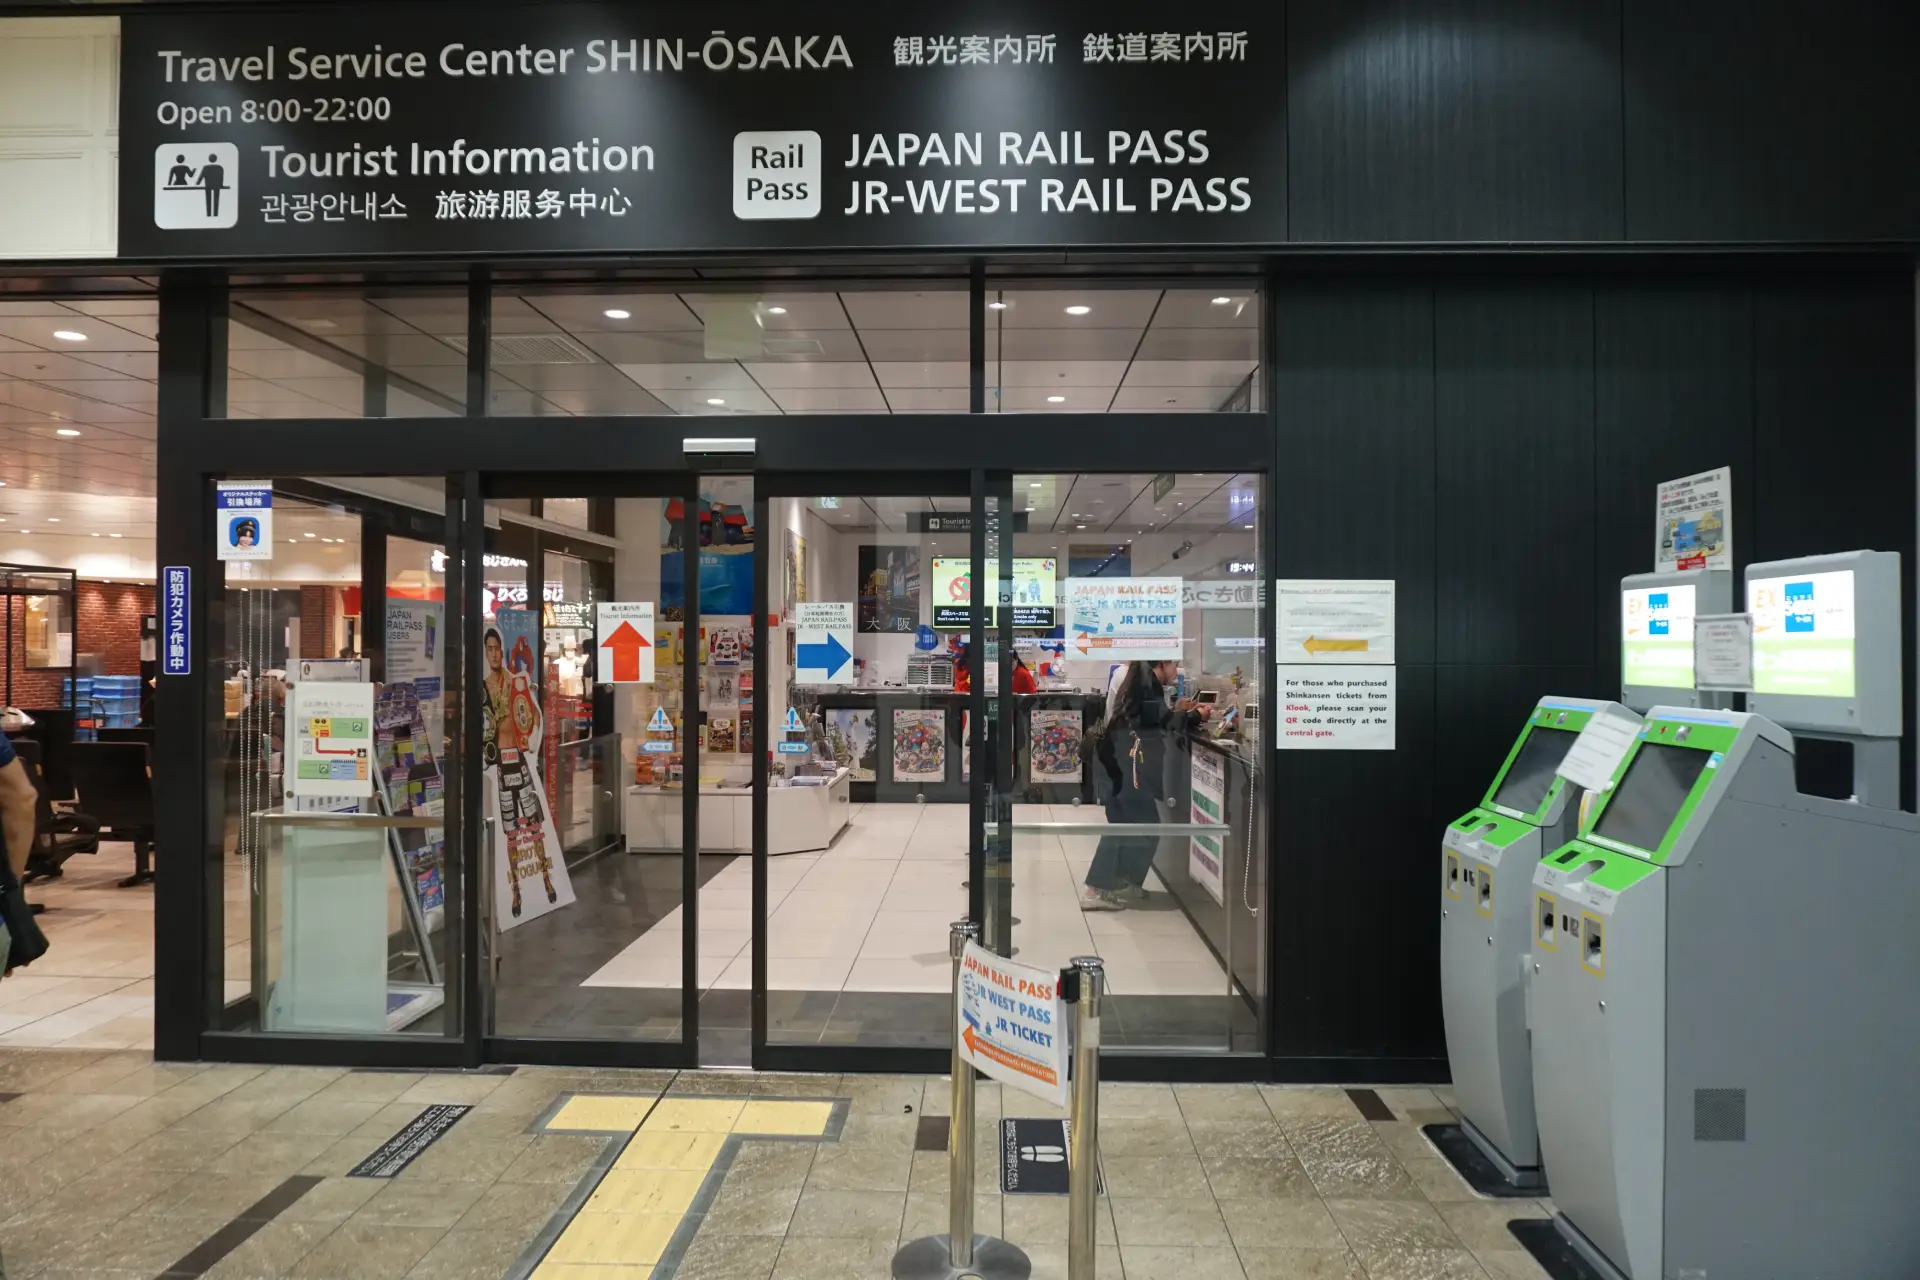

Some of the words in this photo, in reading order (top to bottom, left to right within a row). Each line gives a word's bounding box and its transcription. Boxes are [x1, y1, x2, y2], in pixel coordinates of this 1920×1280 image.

[158, 47, 275, 83] Travel
[288, 44, 426, 79] Service
[438, 43, 574, 77] Center
[586, 31, 854, 73] SHIN-ŌSAKA
[893, 34, 1057, 66] 観光案内所
[1082, 31, 1249, 64] 鉄道案内所
[157, 101, 232, 130] Open
[241, 97, 391, 124] 8:00-22:00
[261, 142, 398, 179] Tourist
[410, 138, 655, 175] Information
[750, 144, 804, 170] Rail
[845, 132, 983, 169] JAPAN
[1000, 131, 1095, 166] RAIL
[1108, 129, 1210, 165] PASS
[435, 188, 632, 221] 旅游服务中心
[746, 176, 809, 203] Pass
[845, 179, 1026, 216] JR-WEST
[1041, 177, 1136, 213] RAIL
[1150, 176, 1252, 212] PASS
[260, 192, 408, 224] 관광안내소
[1075, 585, 1115, 595] JAPAN
[1117, 585, 1144, 595] RAIL
[1148, 585, 1177, 595] PASS
[1113, 600, 1144, 609] WEST
[1148, 600, 1177, 609] PASS
[170, 570, 185, 670] 防犯カメラ作動中
[1119, 615, 1133, 624] JR
[1135, 615, 1177, 624] TICKET
[1347, 680, 1388, 688] purchased
[1316, 705, 1342, 713] please
[1326, 717, 1357, 725] directly
[1315, 730, 1335, 738] gate.
[964, 954, 989, 979] JAPAN
[991, 969, 1015, 991] RAIL
[1018, 978, 1052, 1001] PASS
[976, 983, 987, 999] JR
[988, 991, 1015, 1013] WEST
[1019, 1003, 1051, 1025] PASS
[995, 1016, 1008, 1033] JR
[1010, 1021, 1052, 1048] TICKET
